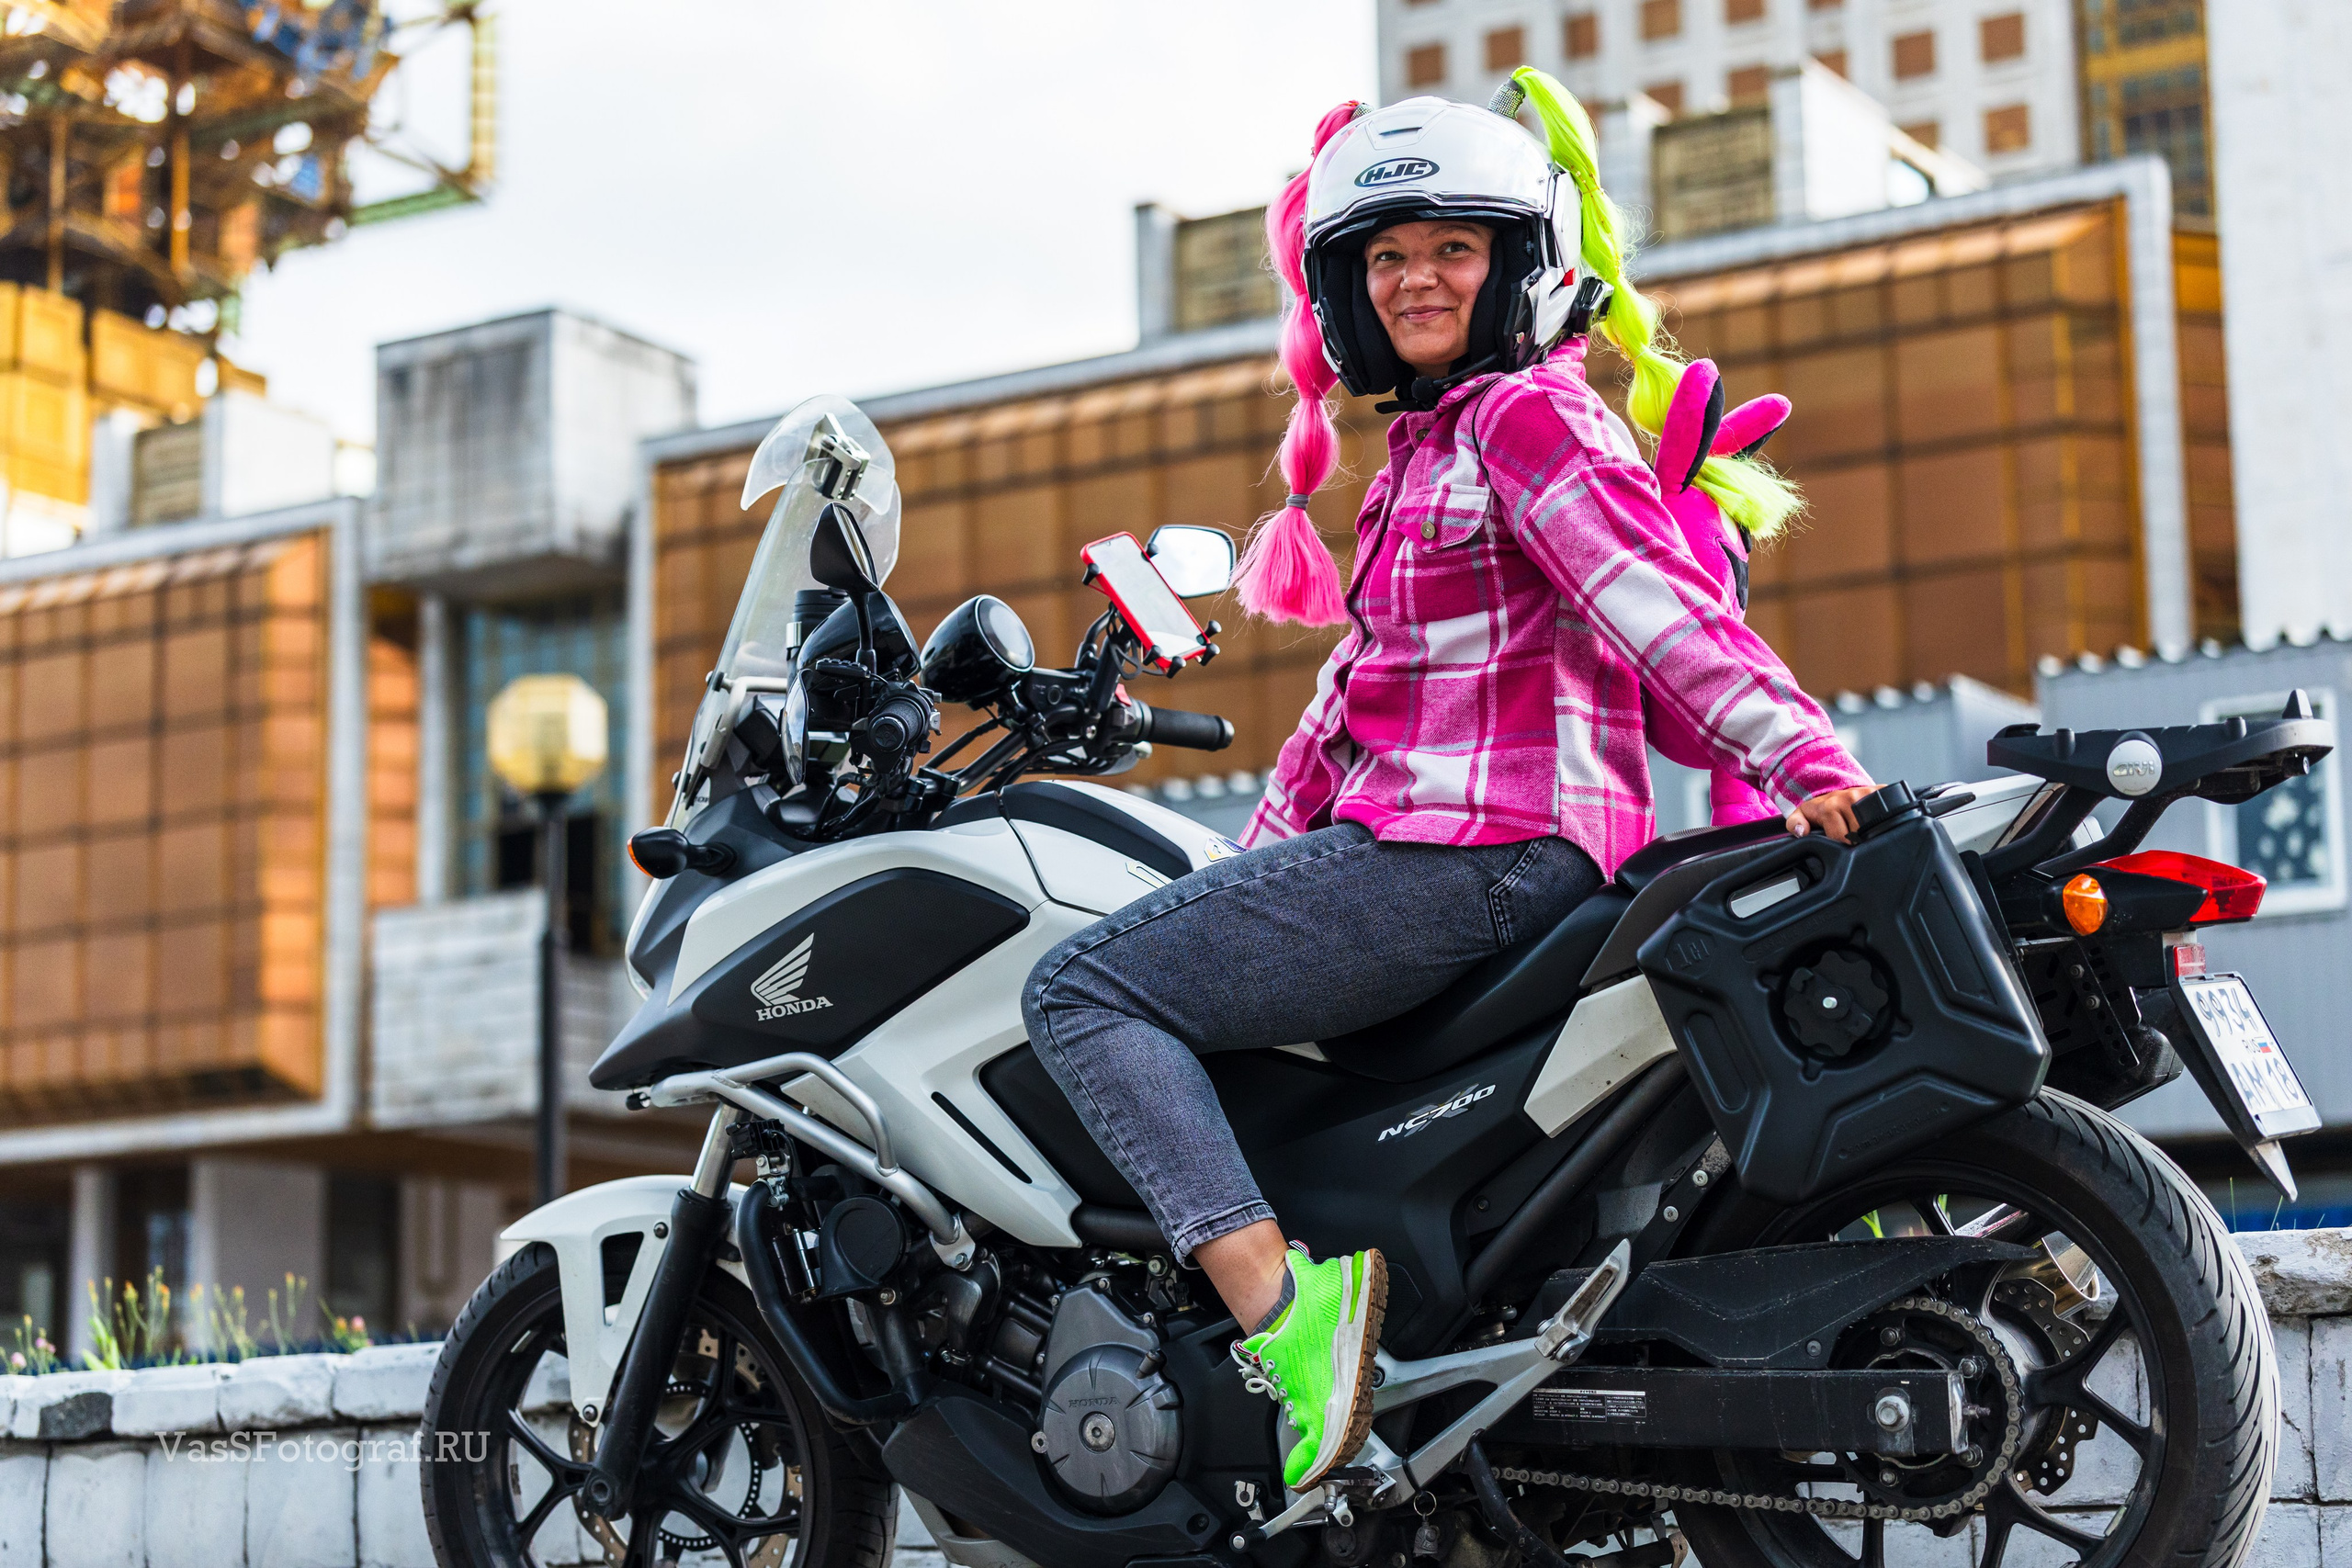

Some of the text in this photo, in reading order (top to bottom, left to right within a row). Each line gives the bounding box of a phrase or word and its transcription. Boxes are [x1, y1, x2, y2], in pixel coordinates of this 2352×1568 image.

[1363, 162, 1429, 185] HJC
[755, 996, 834, 1021] HONDA
[2196, 987, 2259, 1038] 9934
[2242, 1039, 2261, 1054] RUS
[1068, 1396, 1121, 1408] HONDA
